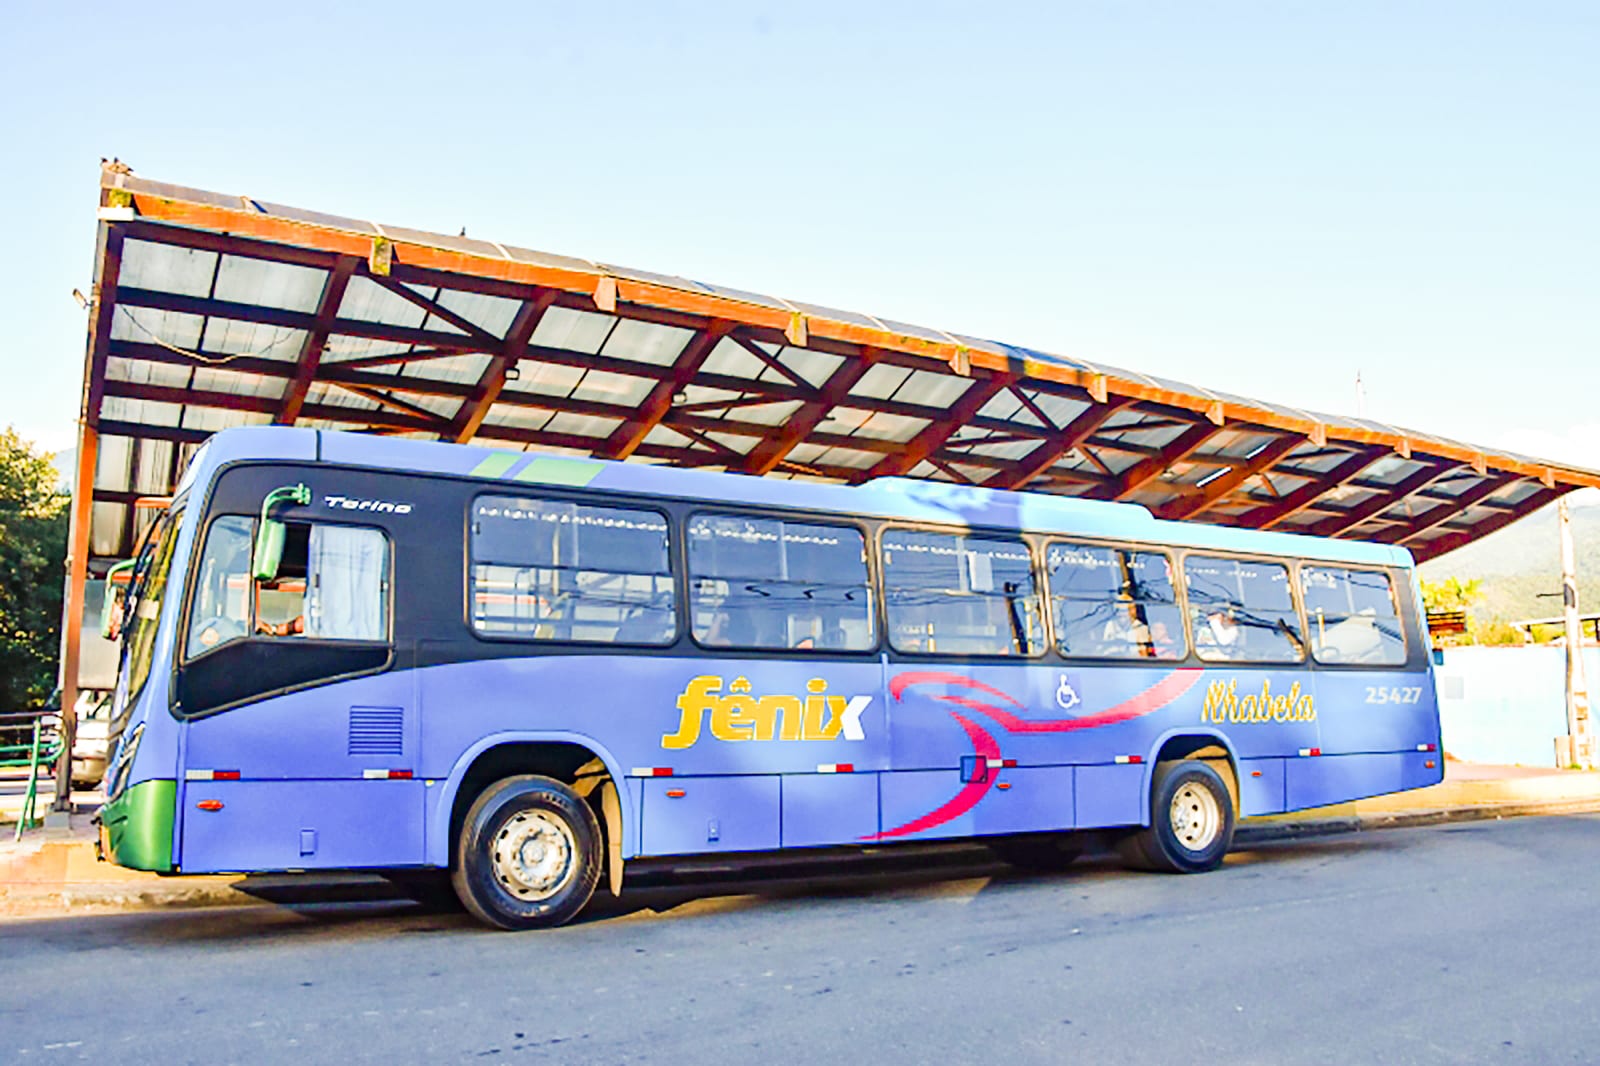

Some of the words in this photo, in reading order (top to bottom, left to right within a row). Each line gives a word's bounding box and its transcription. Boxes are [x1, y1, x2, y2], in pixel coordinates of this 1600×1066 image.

[324, 496, 411, 514] Torino
[1365, 687, 1422, 705] 25427
[661, 675, 873, 750] fênix
